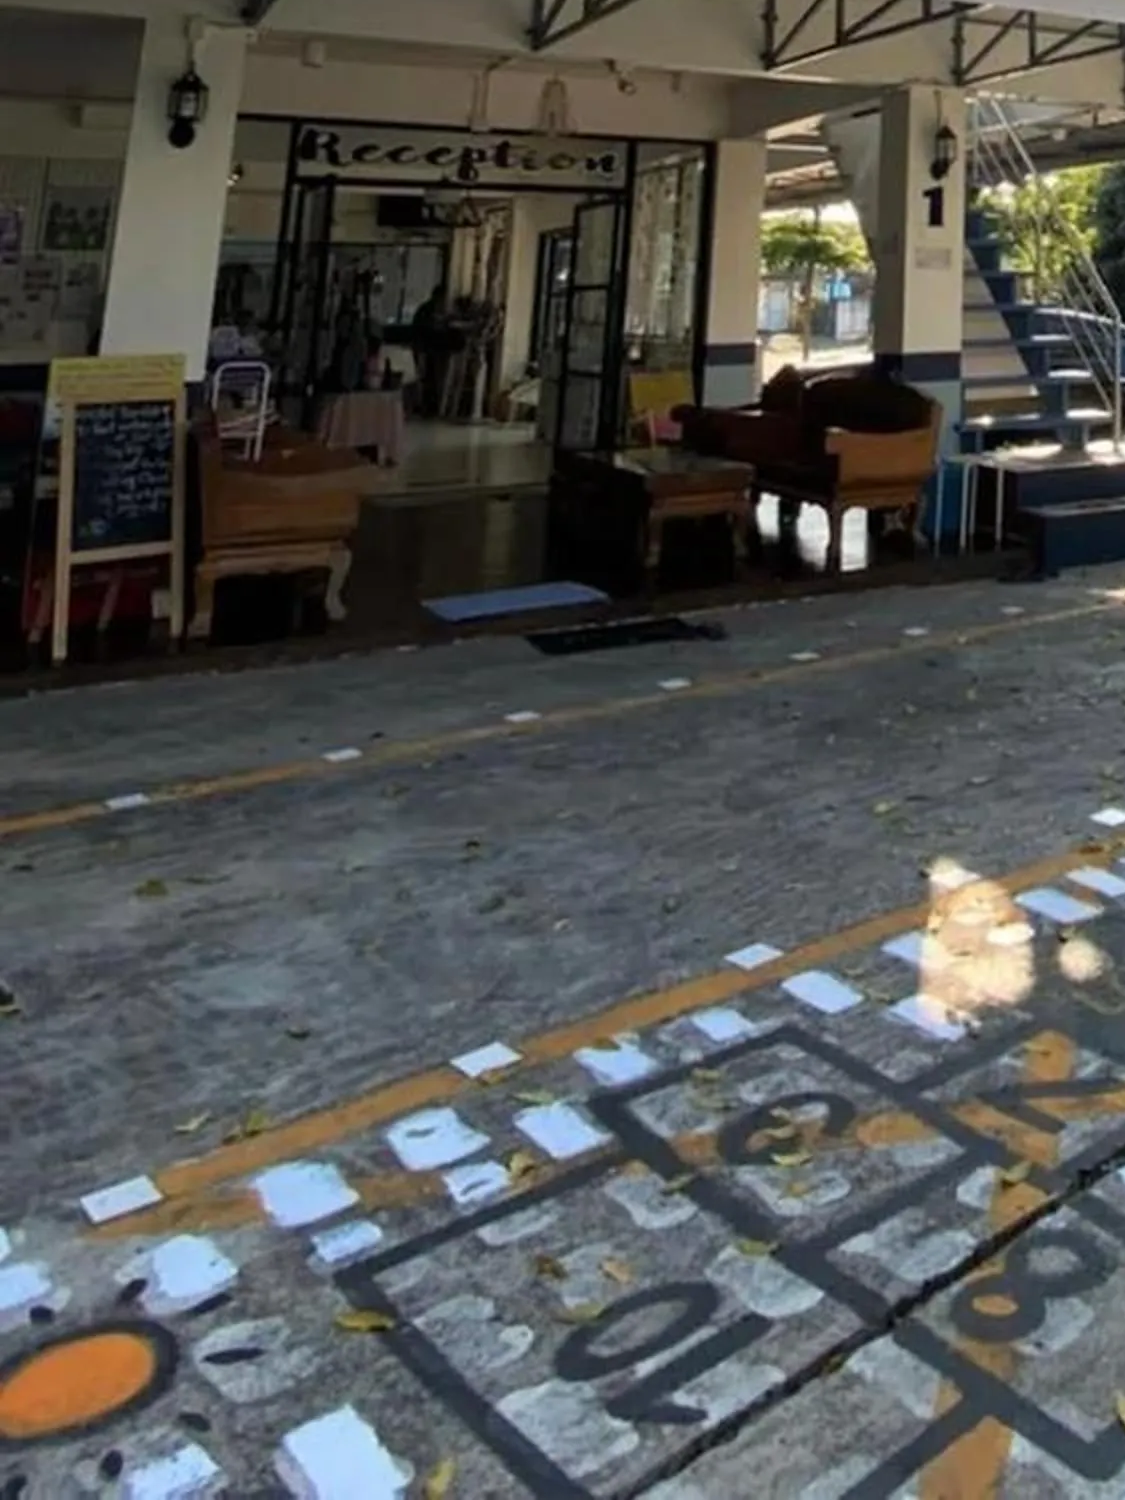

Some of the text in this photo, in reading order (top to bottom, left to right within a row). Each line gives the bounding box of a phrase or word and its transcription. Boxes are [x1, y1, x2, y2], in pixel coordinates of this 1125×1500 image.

[300, 129, 616, 182] Reception
[922, 186, 944, 227] 1
[951, 1224, 1120, 1340] 8
[553, 1280, 772, 1425] 10
